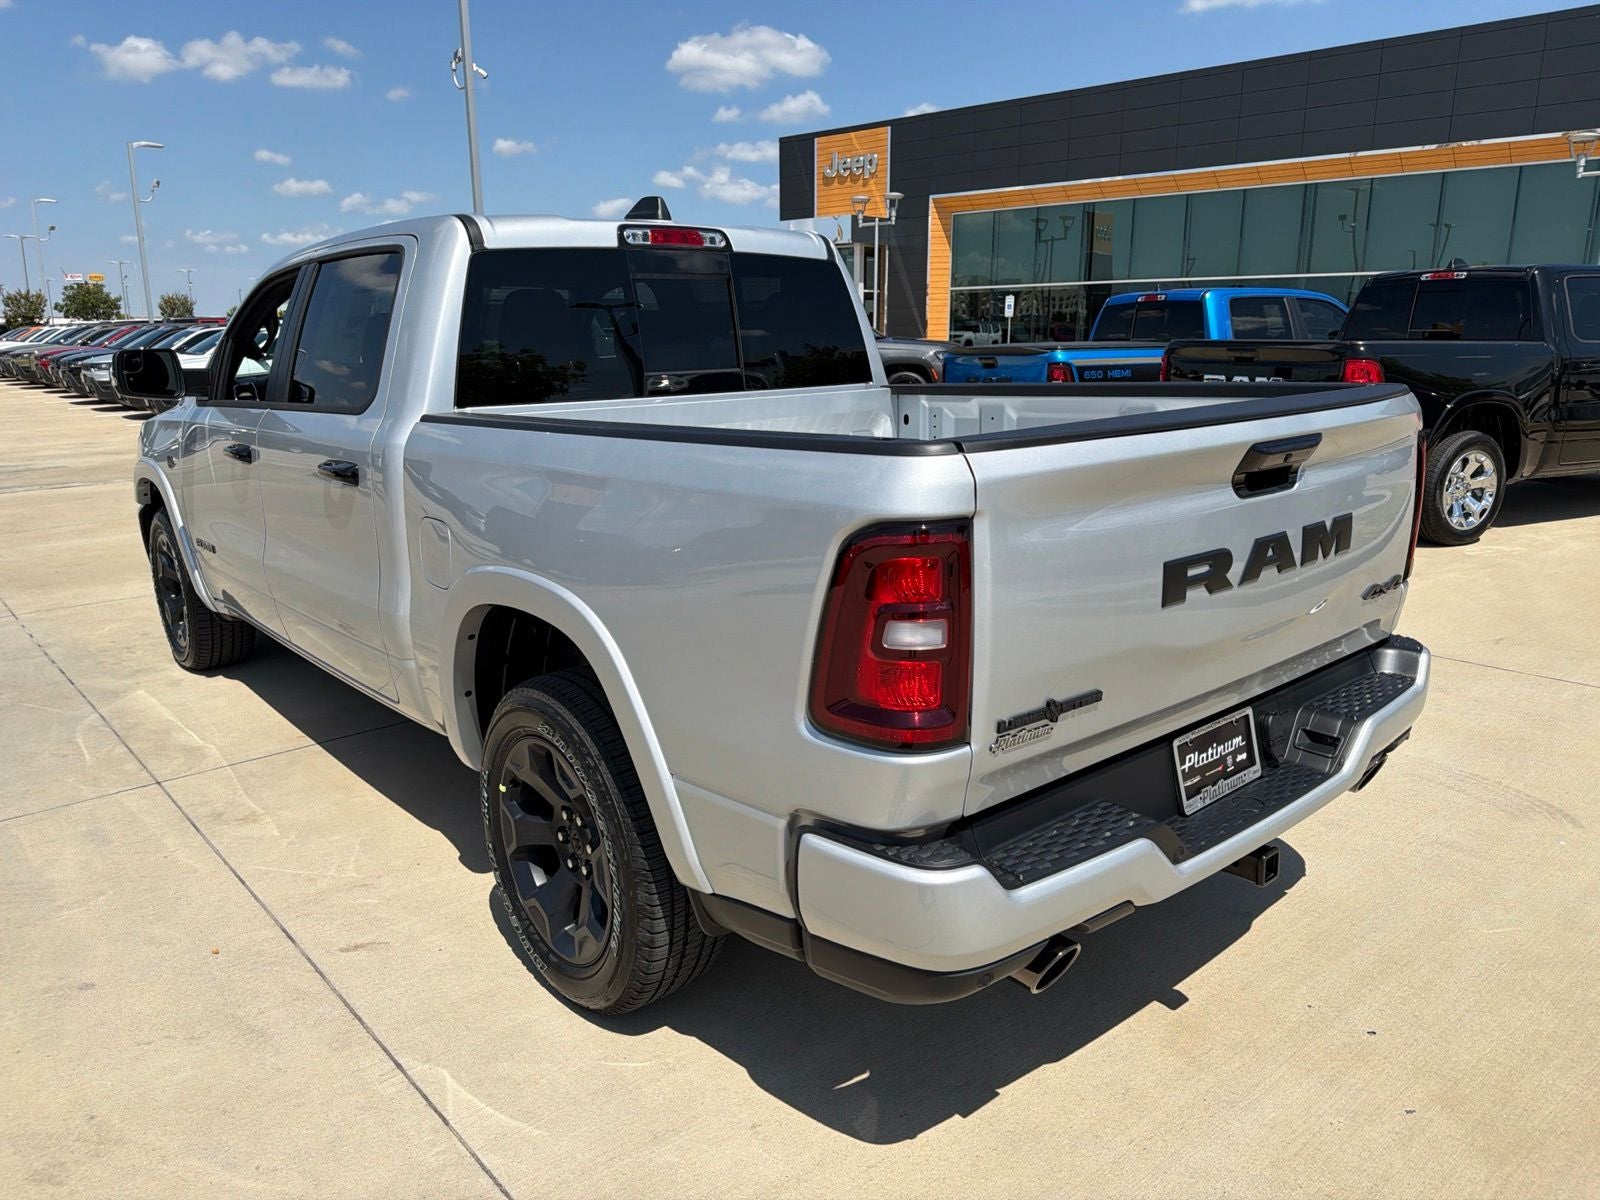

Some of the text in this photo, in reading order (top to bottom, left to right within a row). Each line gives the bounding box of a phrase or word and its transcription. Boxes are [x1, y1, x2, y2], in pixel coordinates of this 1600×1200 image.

[823, 152, 878, 177] Jeep
[1083, 368, 1132, 379] 650 HEMI
[1161, 512, 1353, 609] RAM
[989, 723, 1054, 754] Platinum
[1180, 735, 1246, 773] Platinum
[1200, 777, 1248, 805] Platinum
